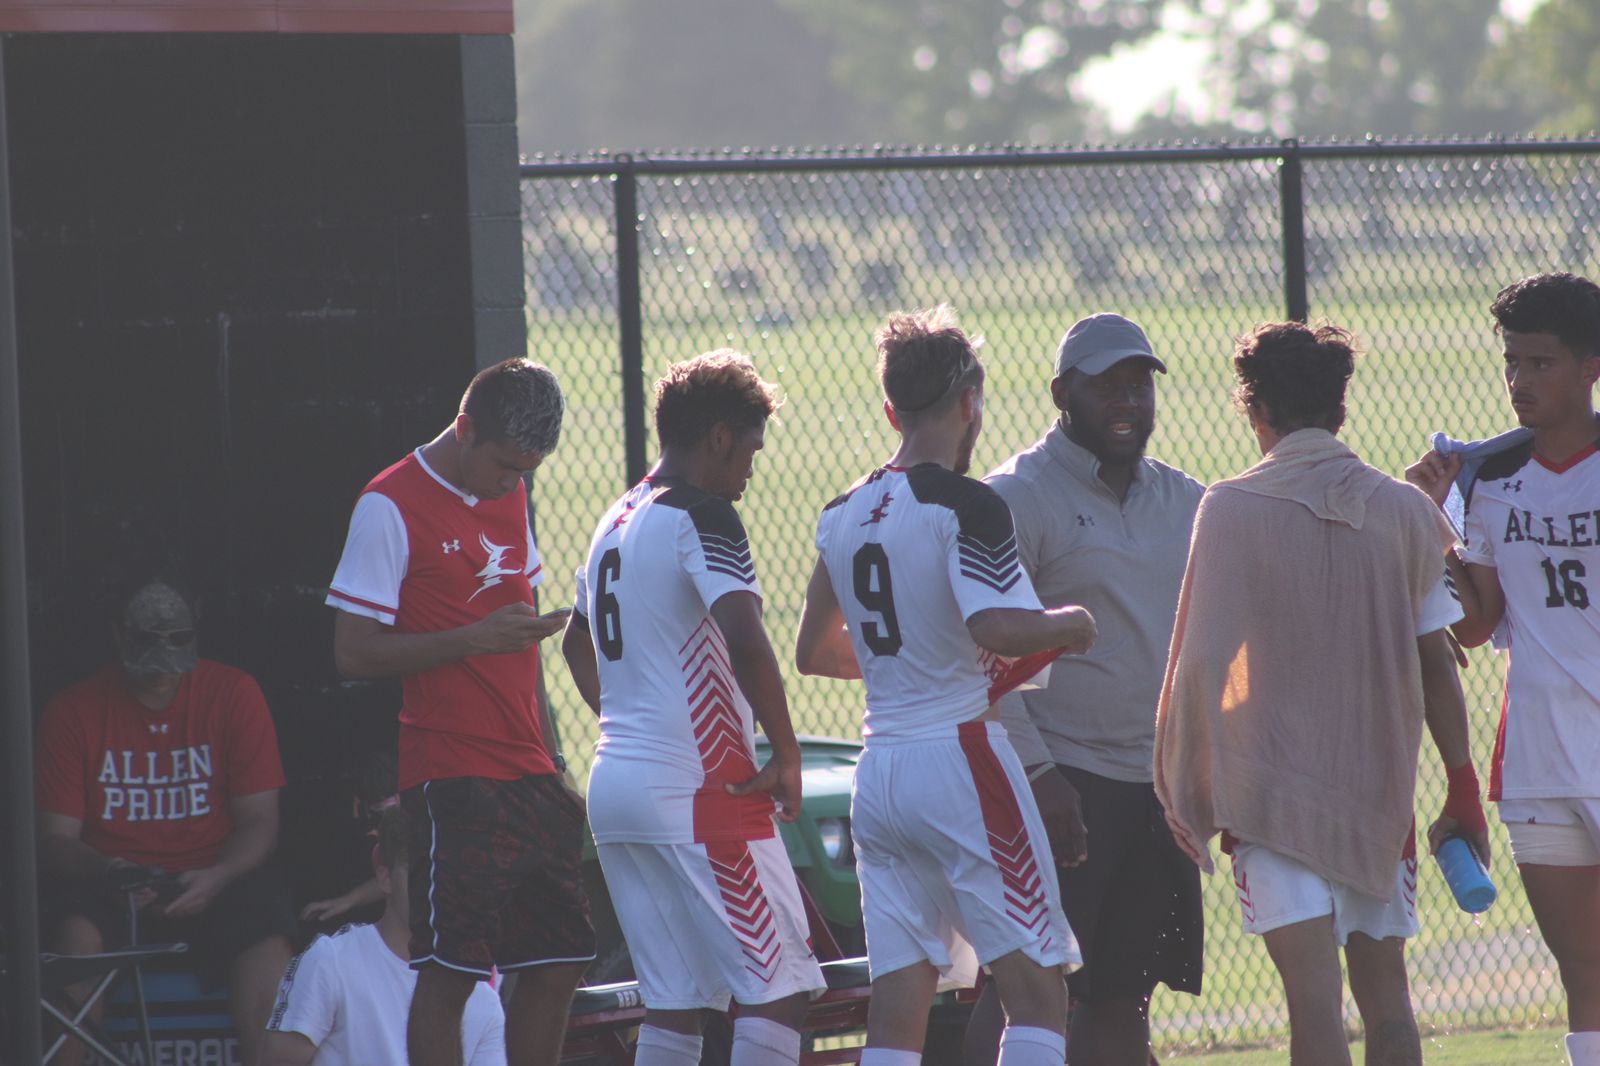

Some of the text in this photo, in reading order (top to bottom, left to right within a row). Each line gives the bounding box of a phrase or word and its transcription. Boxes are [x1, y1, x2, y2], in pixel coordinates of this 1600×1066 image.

[596, 547, 623, 662] 6
[853, 543, 903, 657] 9
[1541, 557, 1590, 610] 16
[98, 745, 212, 784] ALLEN
[102, 783, 210, 821] PRIDE
